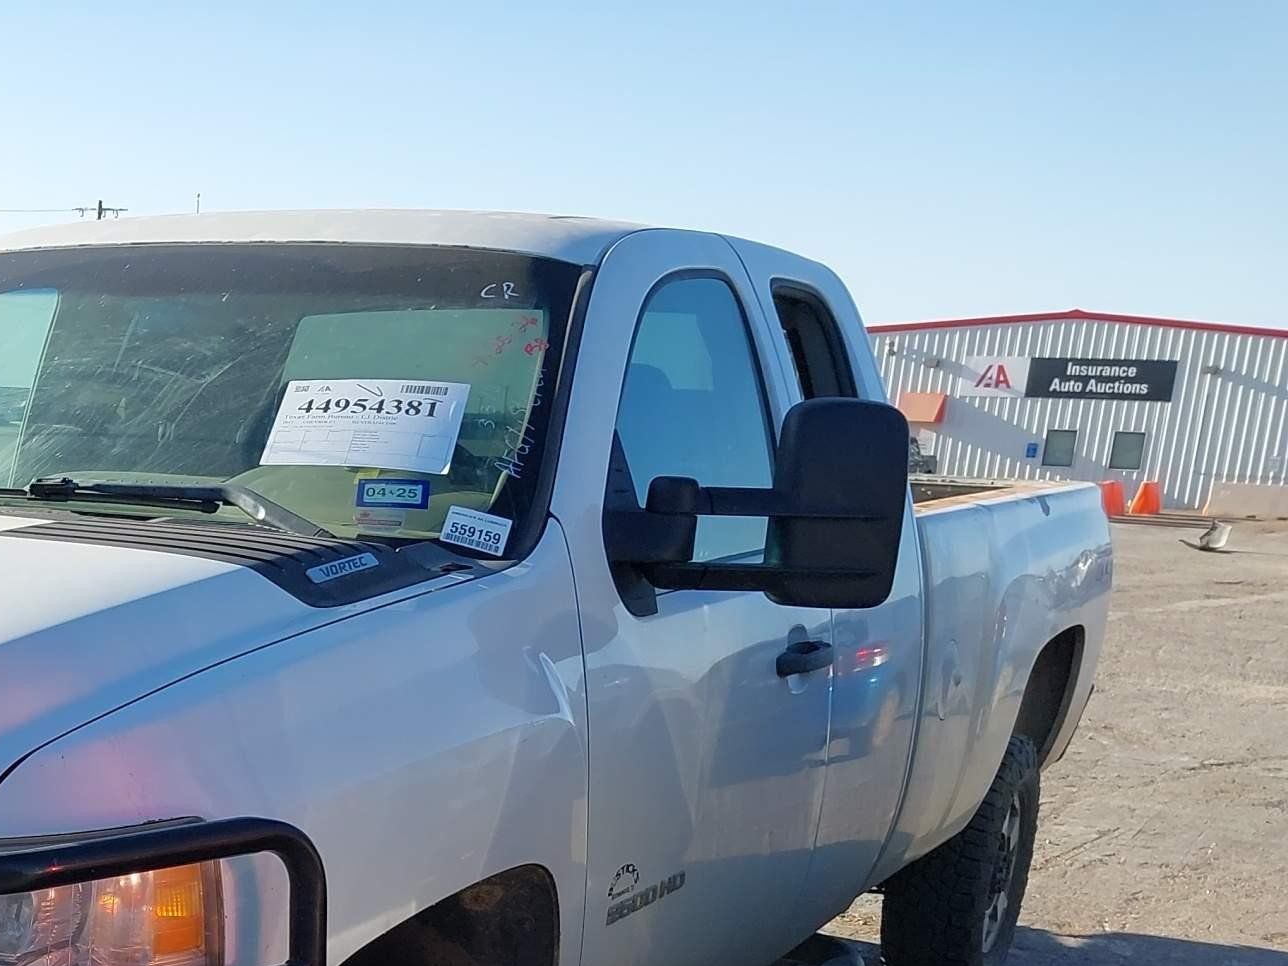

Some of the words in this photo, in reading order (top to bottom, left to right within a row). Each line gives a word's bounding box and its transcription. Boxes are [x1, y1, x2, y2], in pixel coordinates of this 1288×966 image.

[1066, 362, 1137, 378] Insurance
[1049, 378, 1083, 392] Auto
[1085, 379, 1149, 394] Auctions
[297, 397, 439, 418] 44954381
[365, 486, 387, 498] 04
[396, 486, 418, 499] 25
[449, 522, 502, 545] 559159
[319, 556, 368, 578] VORTEC
